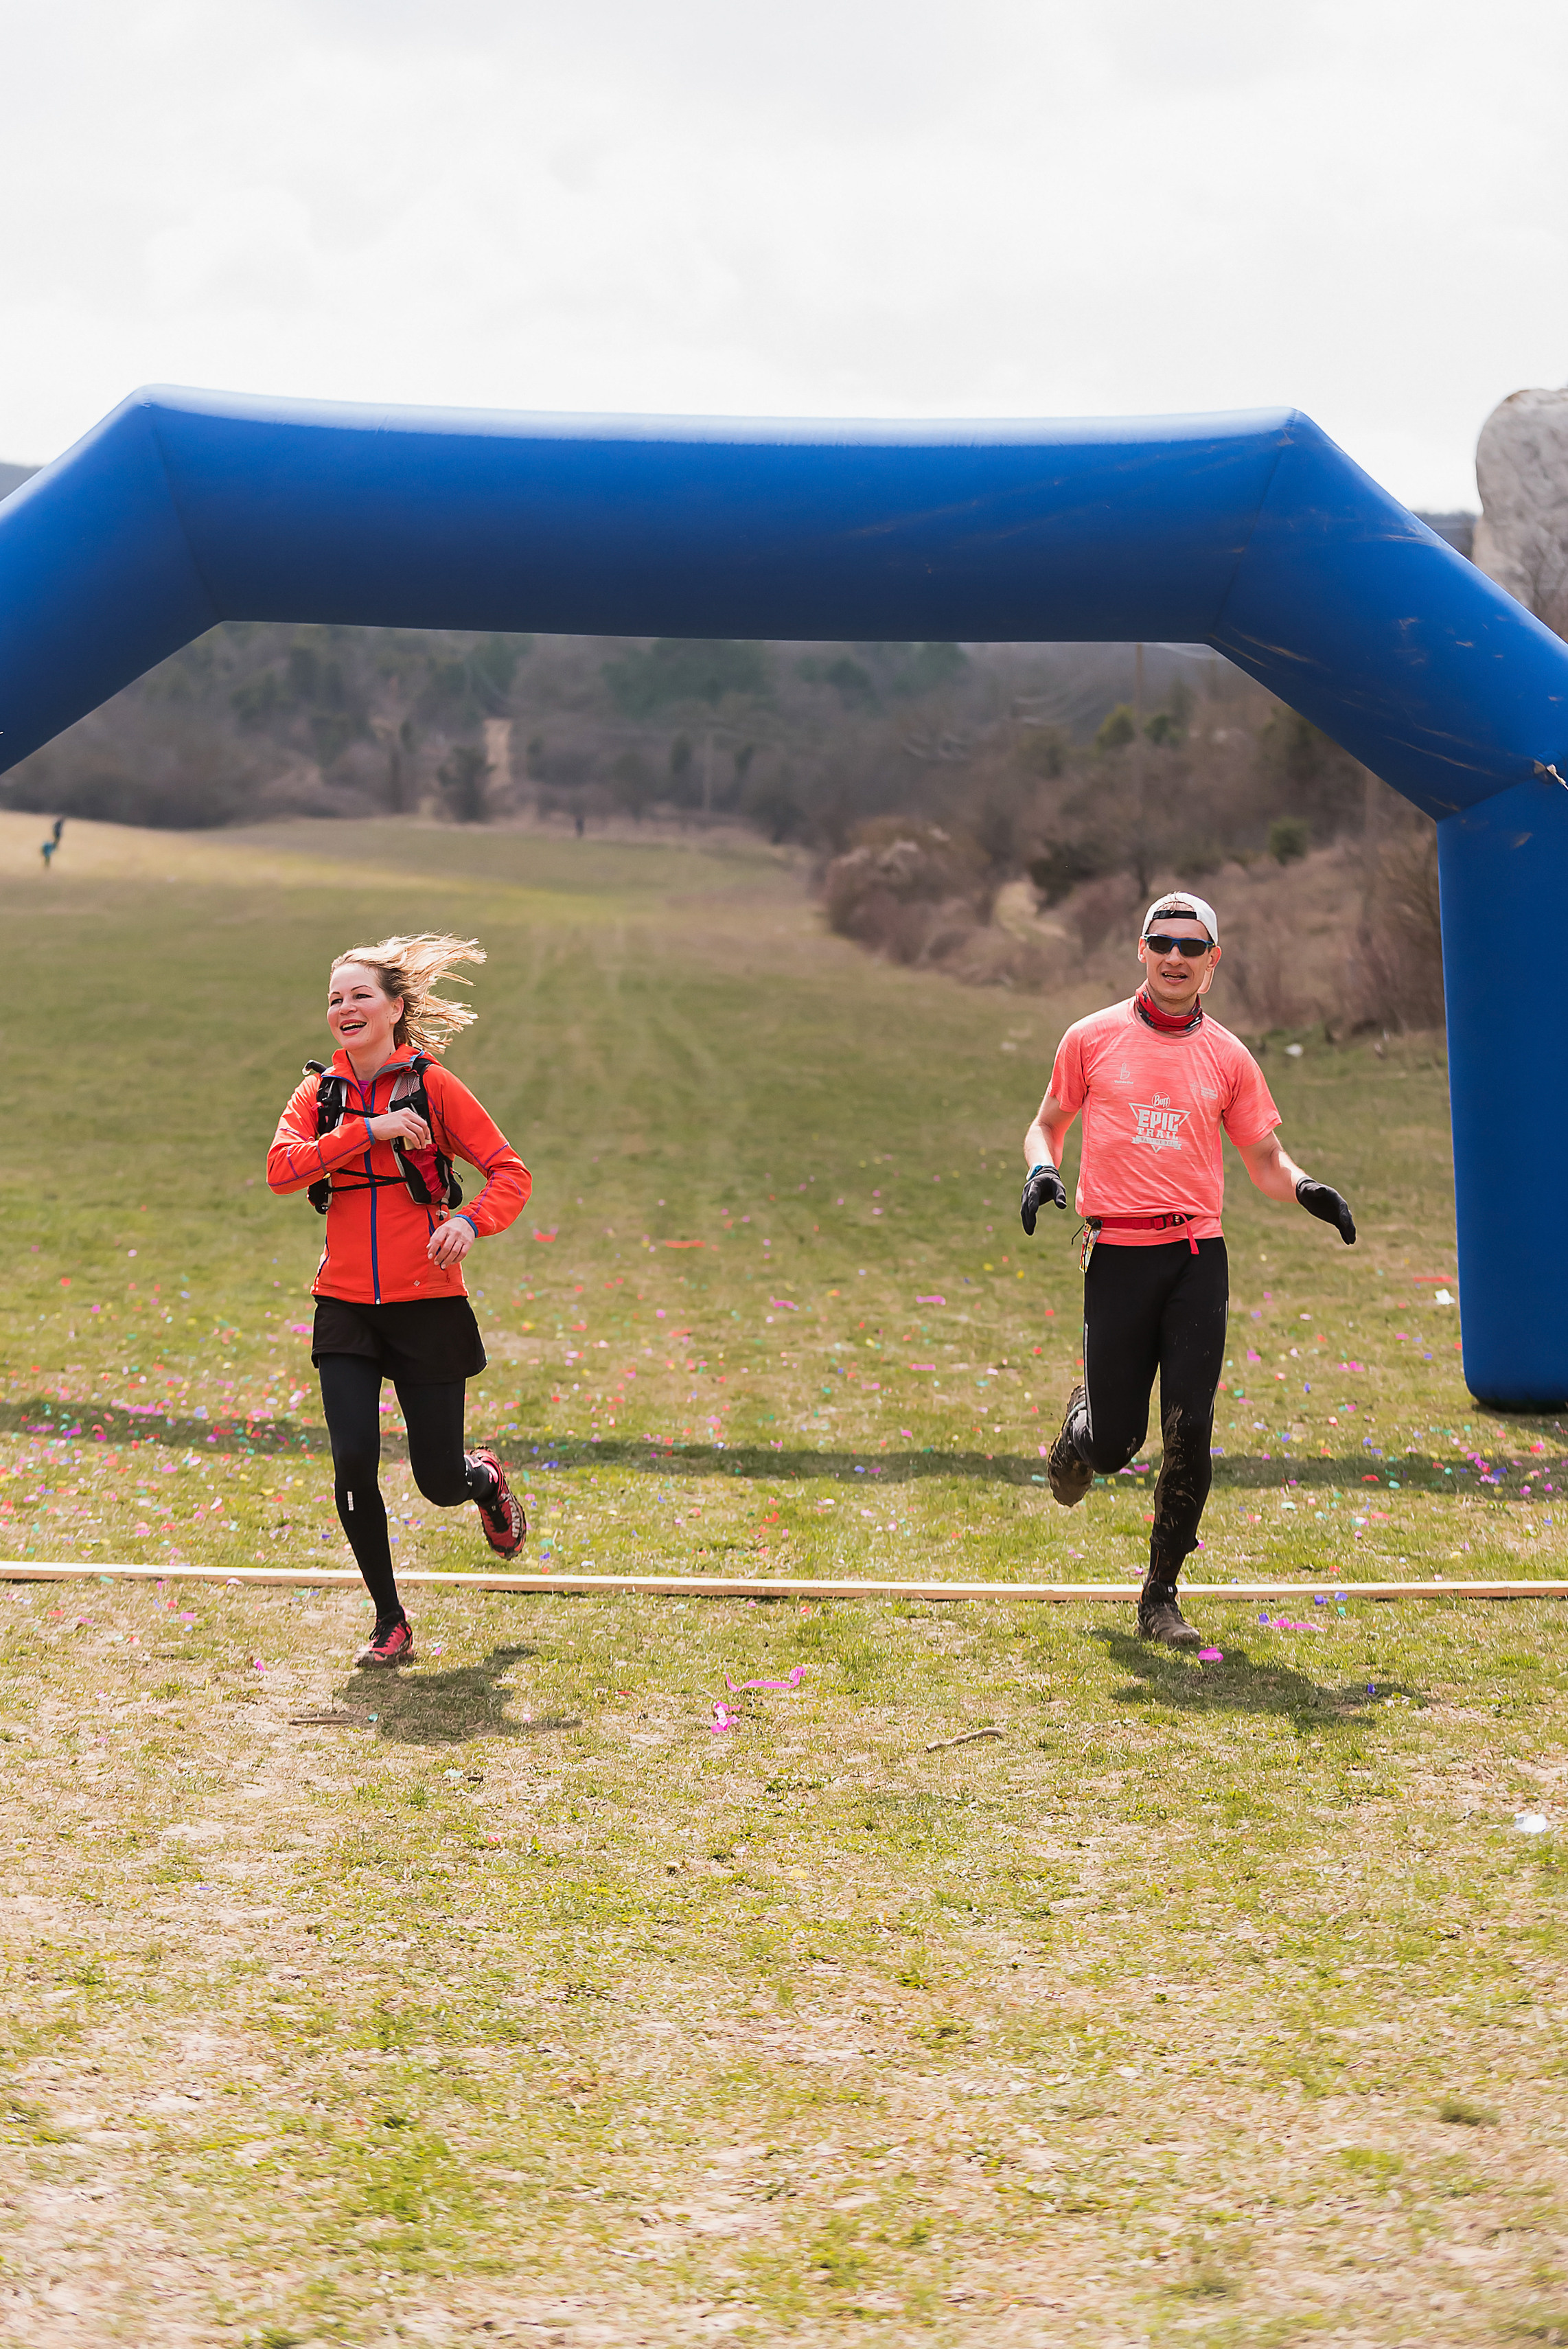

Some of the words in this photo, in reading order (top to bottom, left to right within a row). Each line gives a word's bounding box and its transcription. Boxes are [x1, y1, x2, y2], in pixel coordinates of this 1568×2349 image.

[1154, 1095, 1169, 1108] Buff
[1138, 1109, 1181, 1132] EPIC
[1137, 1127, 1178, 1140] TRAIL
